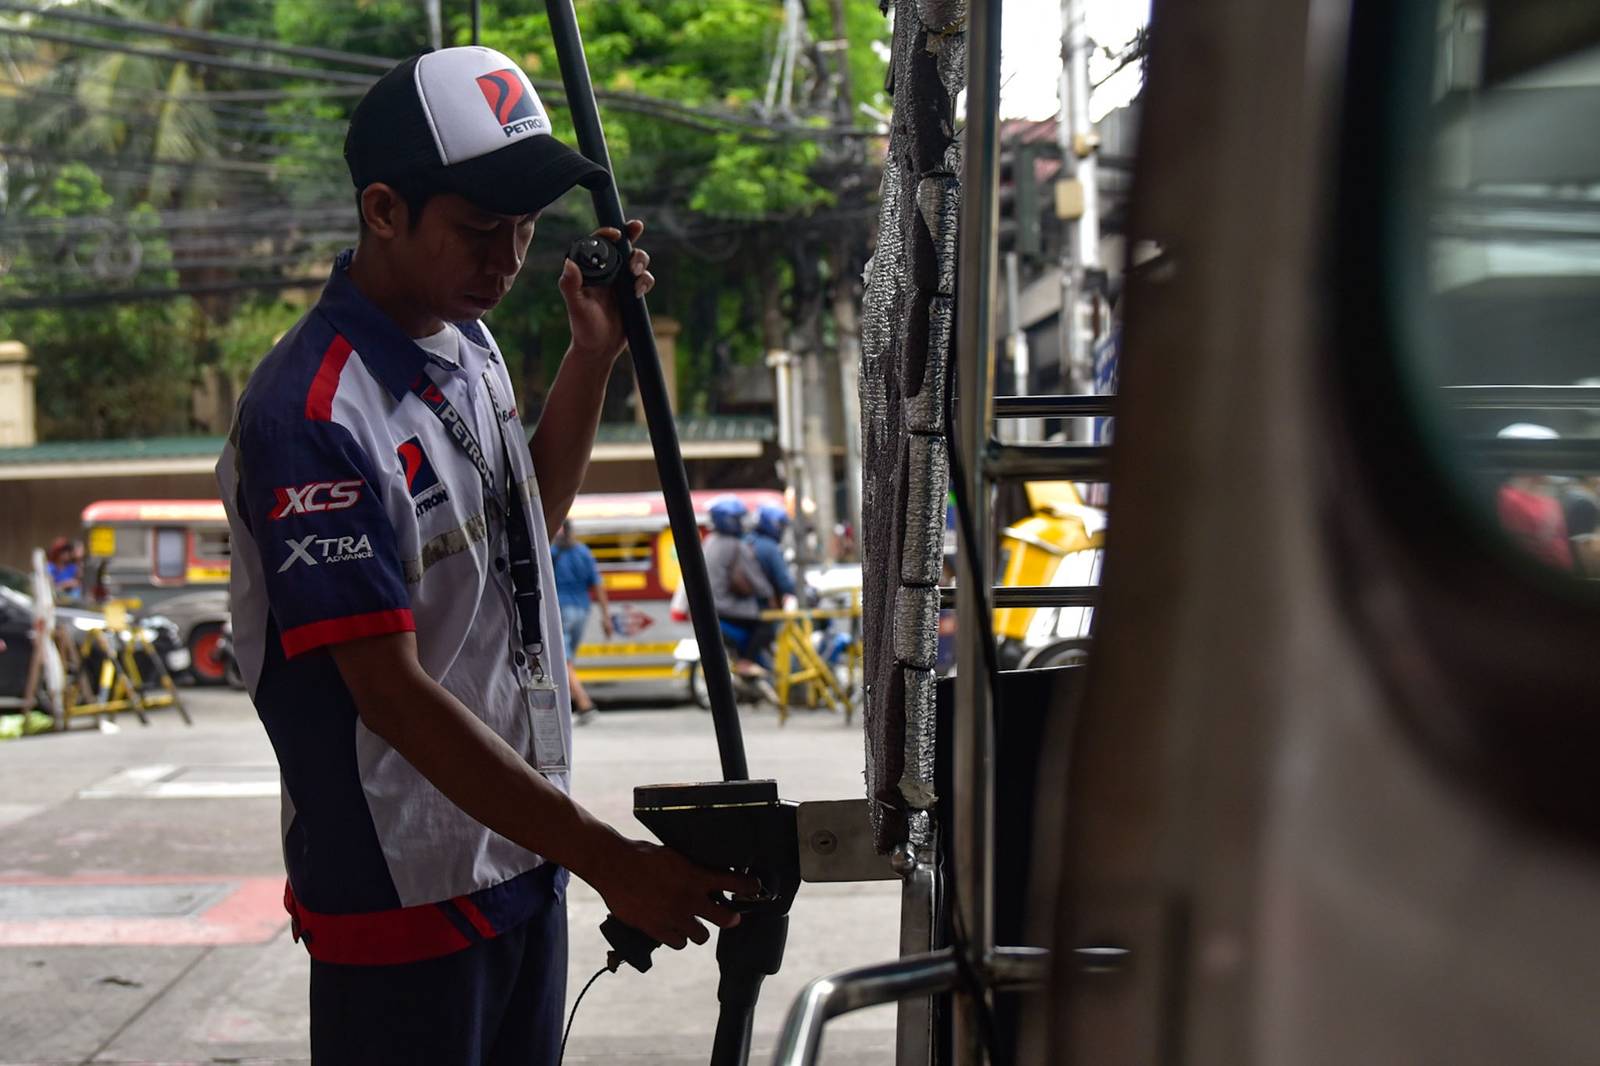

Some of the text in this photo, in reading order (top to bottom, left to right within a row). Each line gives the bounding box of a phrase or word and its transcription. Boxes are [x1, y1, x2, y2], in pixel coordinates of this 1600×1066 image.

[503, 118, 544, 138] PETRO
[276, 480, 363, 518] XCS
[277, 534, 372, 573] XTRA
[326, 551, 374, 563] ADVANCE
